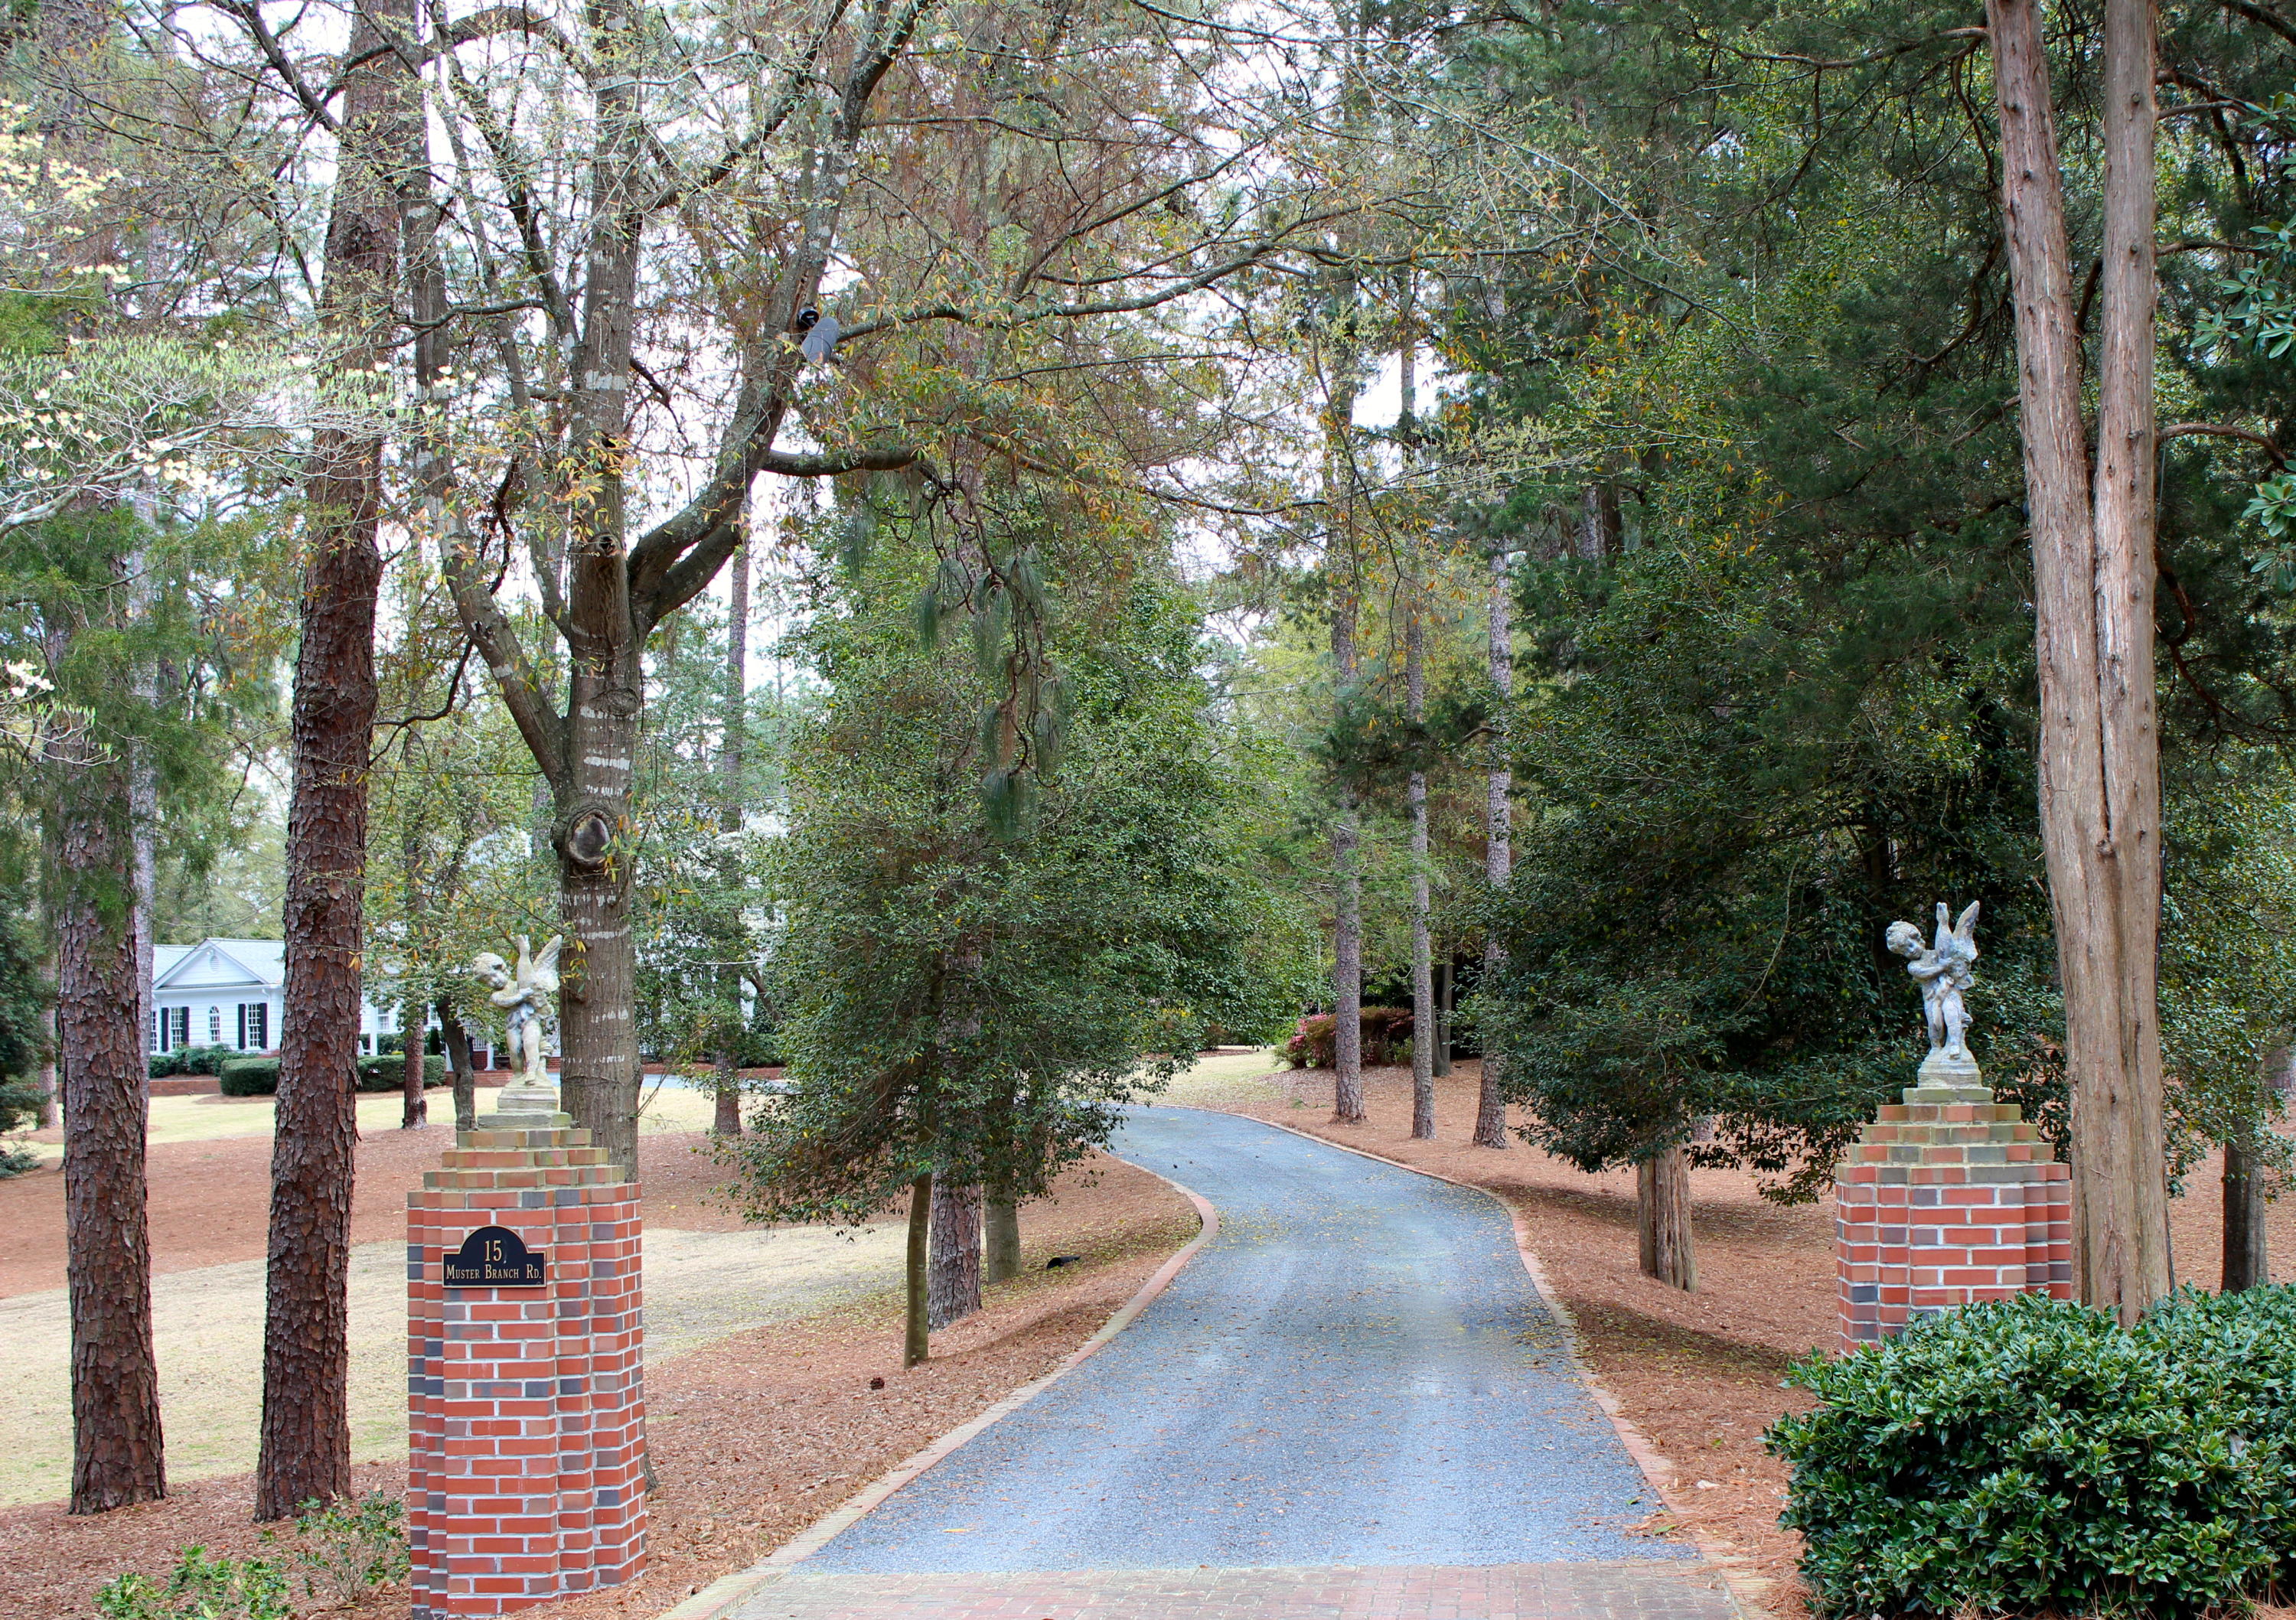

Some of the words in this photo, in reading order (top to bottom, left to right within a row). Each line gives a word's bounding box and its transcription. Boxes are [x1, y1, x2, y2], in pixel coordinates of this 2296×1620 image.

[484, 1240, 502, 1262] 15
[446, 1264, 480, 1279] MUSTER
[485, 1263, 519, 1279] BRANCH
